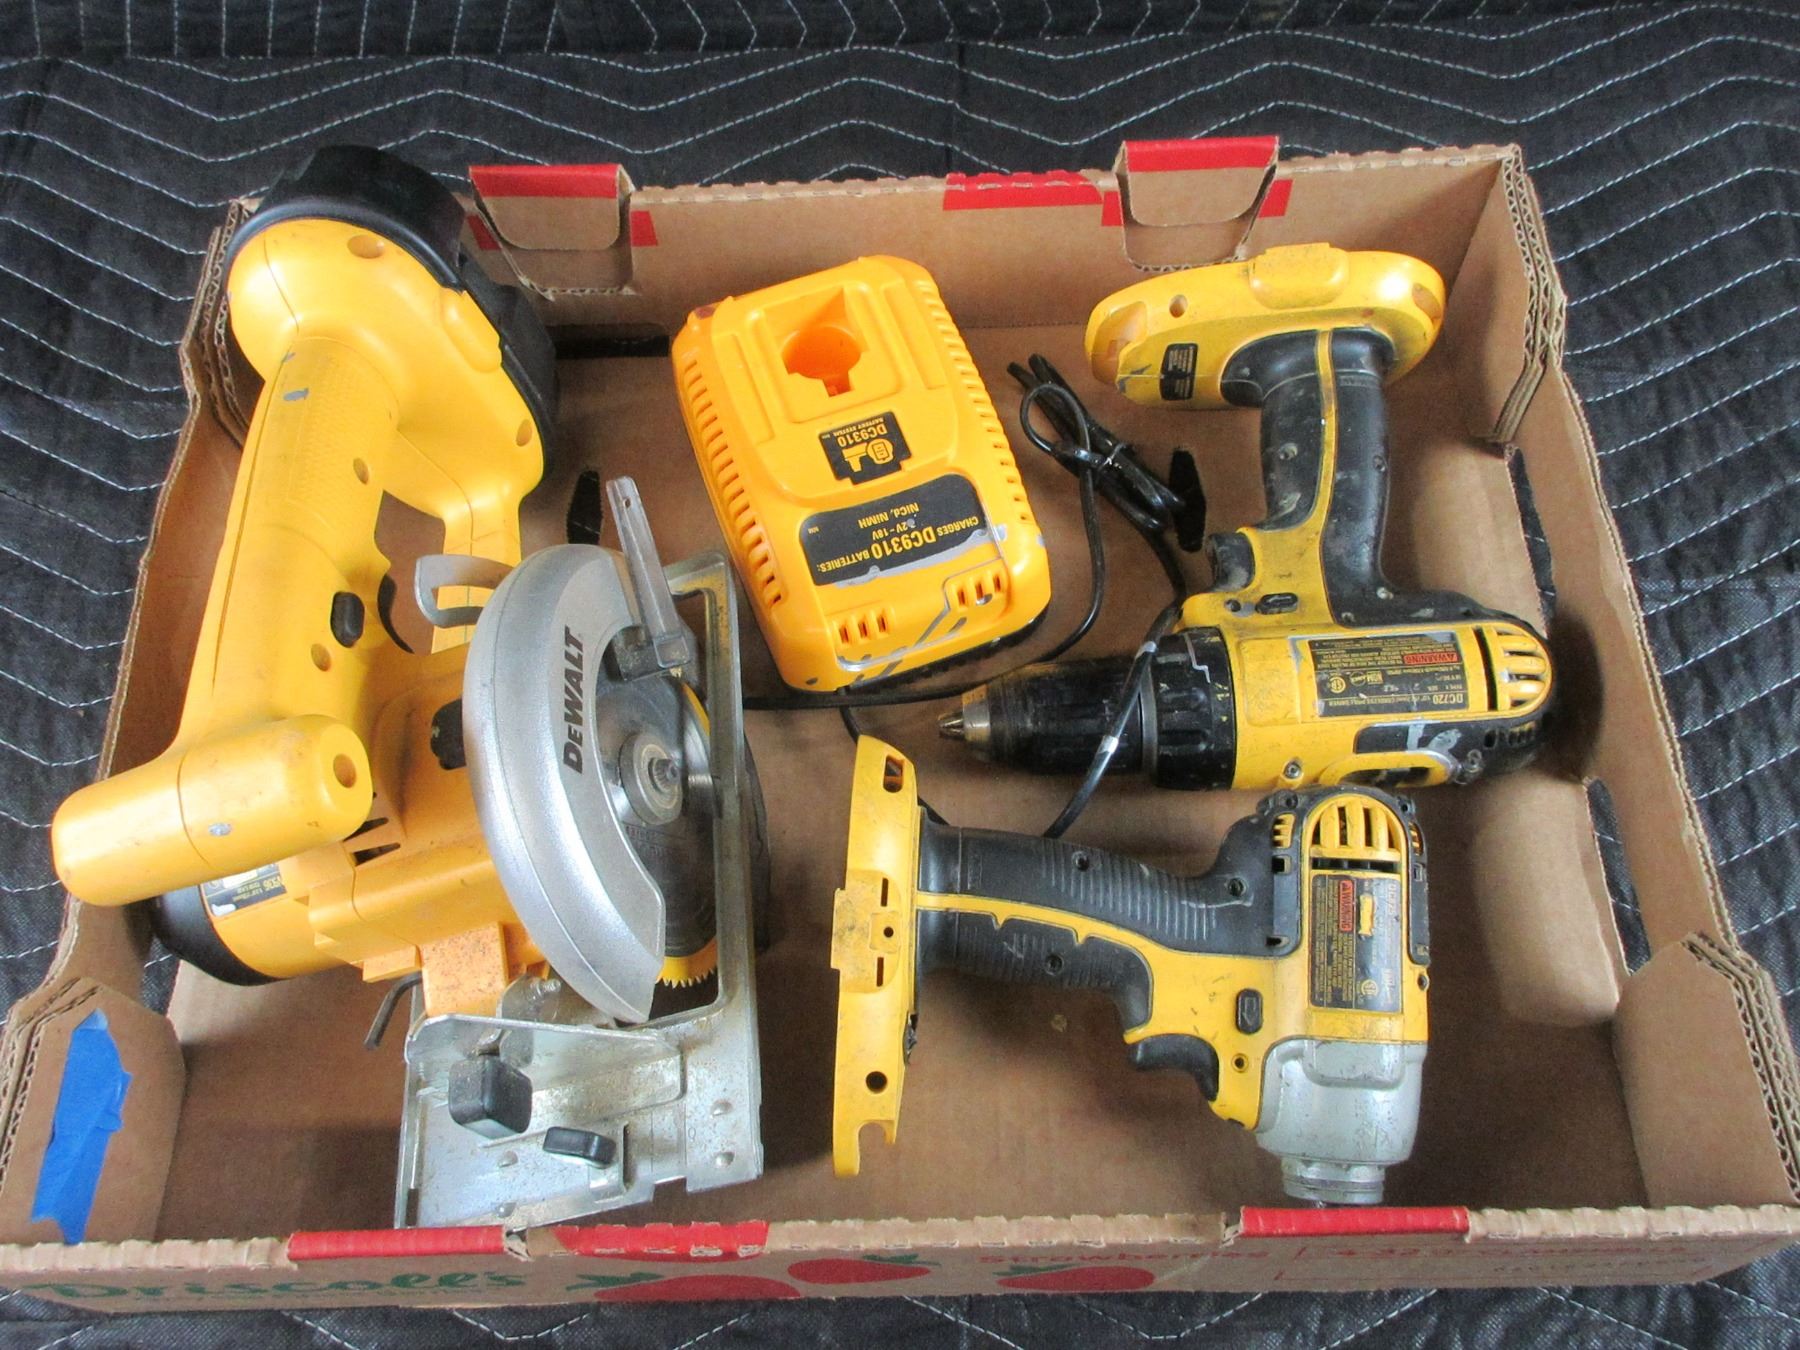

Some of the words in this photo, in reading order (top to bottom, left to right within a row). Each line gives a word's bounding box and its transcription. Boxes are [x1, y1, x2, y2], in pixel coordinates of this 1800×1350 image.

[837, 424, 888, 447] DC9310
[937, 516, 979, 537] CHARGES
[870, 526, 937, 559] DC9310
[816, 551, 871, 573] BATTERIES:
[1406, 653, 1447, 665] WARNING
[1432, 693, 1464, 705] DC720
[1341, 891, 1352, 929] WARNING
[979, 1251, 1270, 1264] Strawberries
